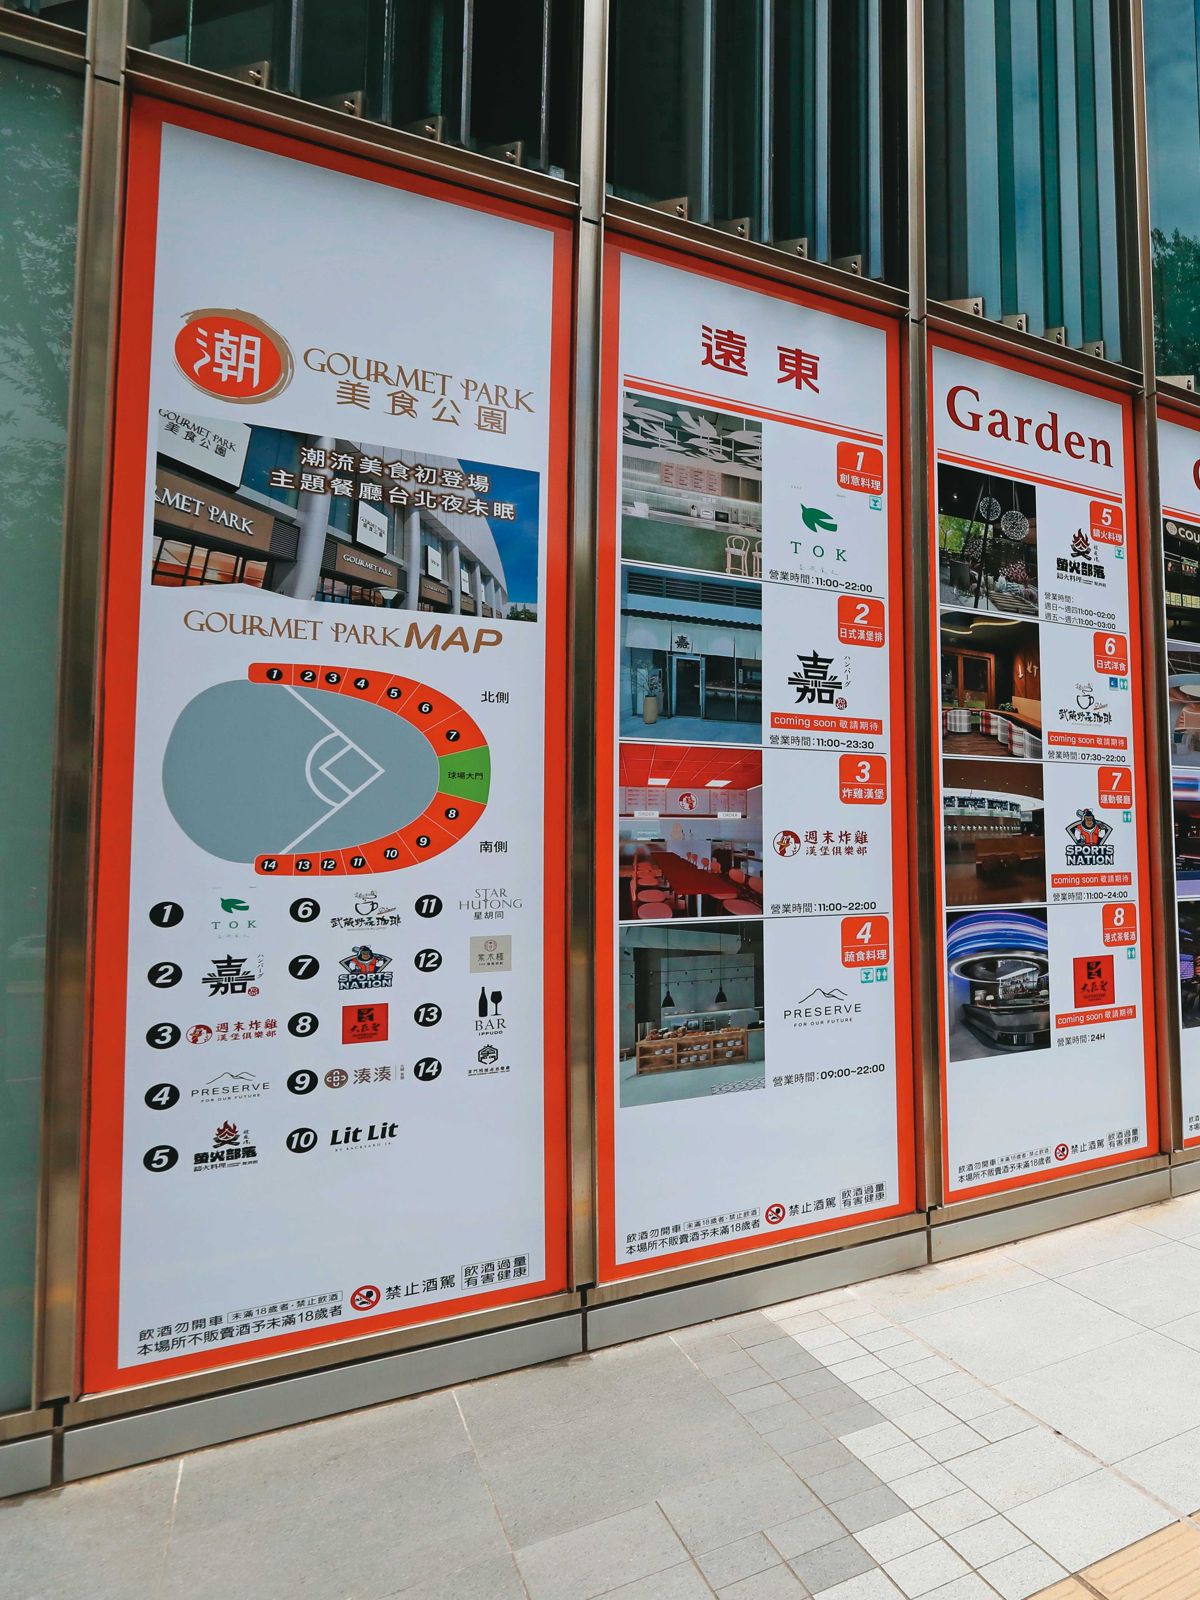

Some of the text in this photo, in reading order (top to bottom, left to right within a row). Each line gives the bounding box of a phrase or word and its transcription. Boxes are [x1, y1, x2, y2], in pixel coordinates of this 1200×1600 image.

[194, 328, 261, 387] 潮
[701, 324, 820, 393] 遠東
[304, 347, 535, 413] GOURMET PARK
[336, 379, 506, 434] 美食公園
[159, 409, 236, 452] GOURMET PARK
[946, 385, 1113, 468] Garden
[164, 422, 226, 457] 美食公園
[856, 451, 864, 470] 1
[301, 447, 489, 493] 潮流美食初登場
[840, 473, 881, 491] 創意料理
[271, 469, 514, 520] 主題餐廳台北夜未眠
[208, 501, 254, 535] PARK
[1101, 508, 1113, 525] 5
[790, 541, 847, 562] TOK
[343, 554, 392, 576] GOURMET PARK
[1056, 558, 1105, 579] 螢火部落
[854, 604, 870, 624] 2
[183, 610, 323, 640] GOURMET
[840, 628, 883, 642] 日式漢堡排
[1105, 638, 1115, 655] 6
[1097, 660, 1126, 671] 日式洋食
[788, 650, 842, 704] 嘉
[481, 691, 509, 704] 北側
[774, 716, 879, 730] coming soon 敬請期待
[1050, 735, 1075, 744] coming
[448, 772, 483, 780] 球場大門
[856, 761, 871, 782] 3
[1112, 772, 1122, 790] 7
[842, 788, 884, 799] 炸雞漢堡
[804, 830, 868, 844] 週末炸雞
[479, 841, 507, 854] 南側
[806, 845, 868, 856] 漢堡俱樂部
[1066, 845, 1114, 855] SPORTS
[1067, 855, 1114, 865] NATION
[1054, 876, 1080, 884] coming
[475, 888, 507, 900] STAR
[459, 899, 522, 910] HUTONG
[474, 911, 504, 920] 星胡同
[1114, 908, 1124, 926] 8
[211, 921, 256, 929] TOK
[856, 922, 872, 943] 4
[844, 950, 887, 962] 蔬食料理
[202, 954, 255, 997] 嘉
[339, 972, 393, 982] SPORTS
[339, 980, 392, 990] NATION
[784, 1003, 862, 1019] PRESERVE
[1058, 1015, 1084, 1024] coming
[216, 1019, 277, 1032] 週末炸雞
[475, 1019, 506, 1031] BAR
[217, 1031, 276, 1041] 漢堡俱樂部
[353, 1066, 391, 1084] 湊湊
[191, 1083, 269, 1097] PRESERVE
[330, 1122, 398, 1145] Lit Lit
[194, 1146, 257, 1165] 螢火部落
[959, 1159, 996, 1173] 飲酒勿開車
[1071, 1139, 1104, 1154] 禁止酒駕
[626, 1183, 885, 1243] 飲酒勿開車 禁止酒駕 飲酒過量
[626, 1192, 885, 1254] 本場所不販賣酒予未滿18歲者 有害健康
[138, 1255, 527, 1342] 飲酒勿開車 禁止酒駕 飲酒過量
[136, 1266, 528, 1356] 本場所不販賣酒予未滿18歲者 有害健康
